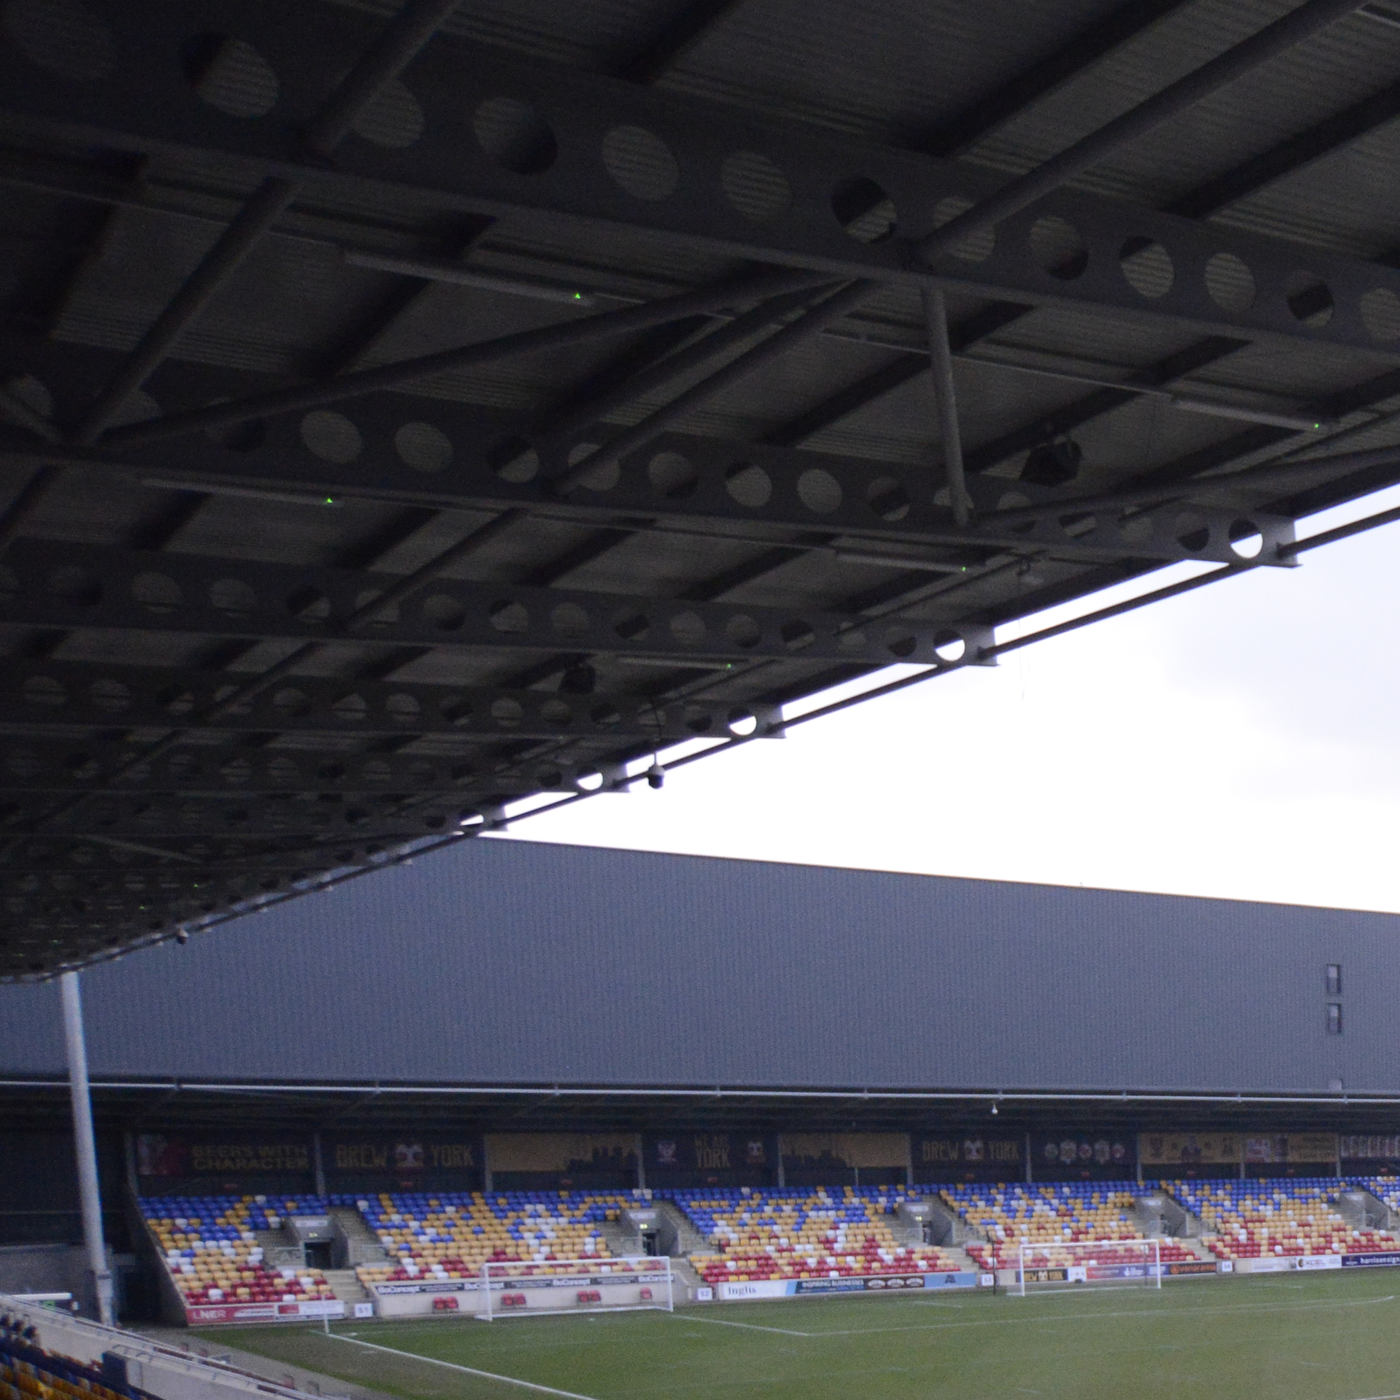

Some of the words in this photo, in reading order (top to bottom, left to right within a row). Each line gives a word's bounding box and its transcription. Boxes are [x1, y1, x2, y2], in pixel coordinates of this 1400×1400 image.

[336, 1144, 388, 1168] BREW
[432, 1144, 474, 1168] YORK
[696, 1149, 731, 1168] YORK
[988, 1141, 1020, 1160] YORK
[192, 1158, 309, 1170] CHARACTER
[464, 1281, 504, 1291] BoConept
[638, 1275, 674, 1283] BoConcet
[728, 1286, 757, 1296] Inglis
